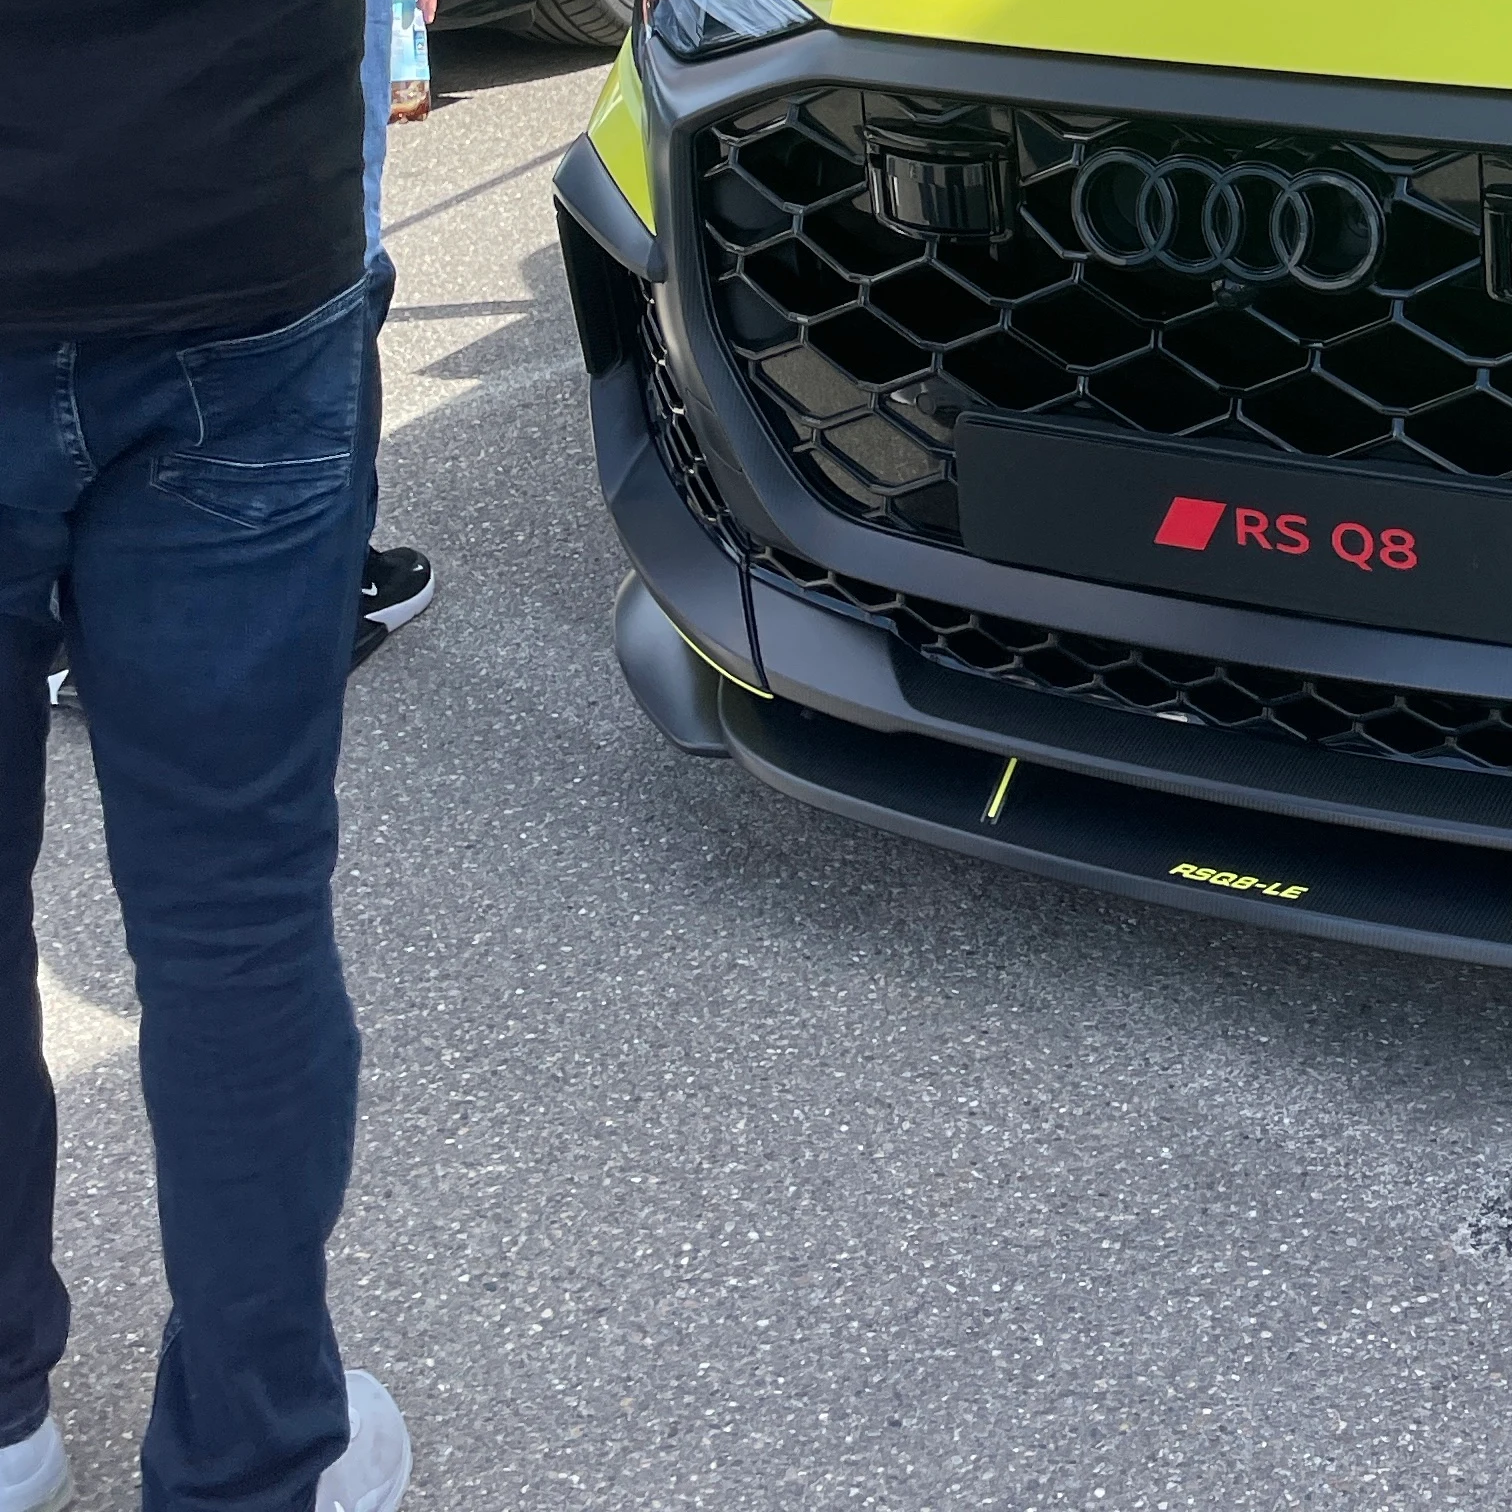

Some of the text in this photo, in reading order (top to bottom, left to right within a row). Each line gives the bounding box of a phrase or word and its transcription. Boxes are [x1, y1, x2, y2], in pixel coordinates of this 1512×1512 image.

[1235, 507, 1419, 573] RS Q8
[1168, 862, 1310, 900] RSQ8-LE
